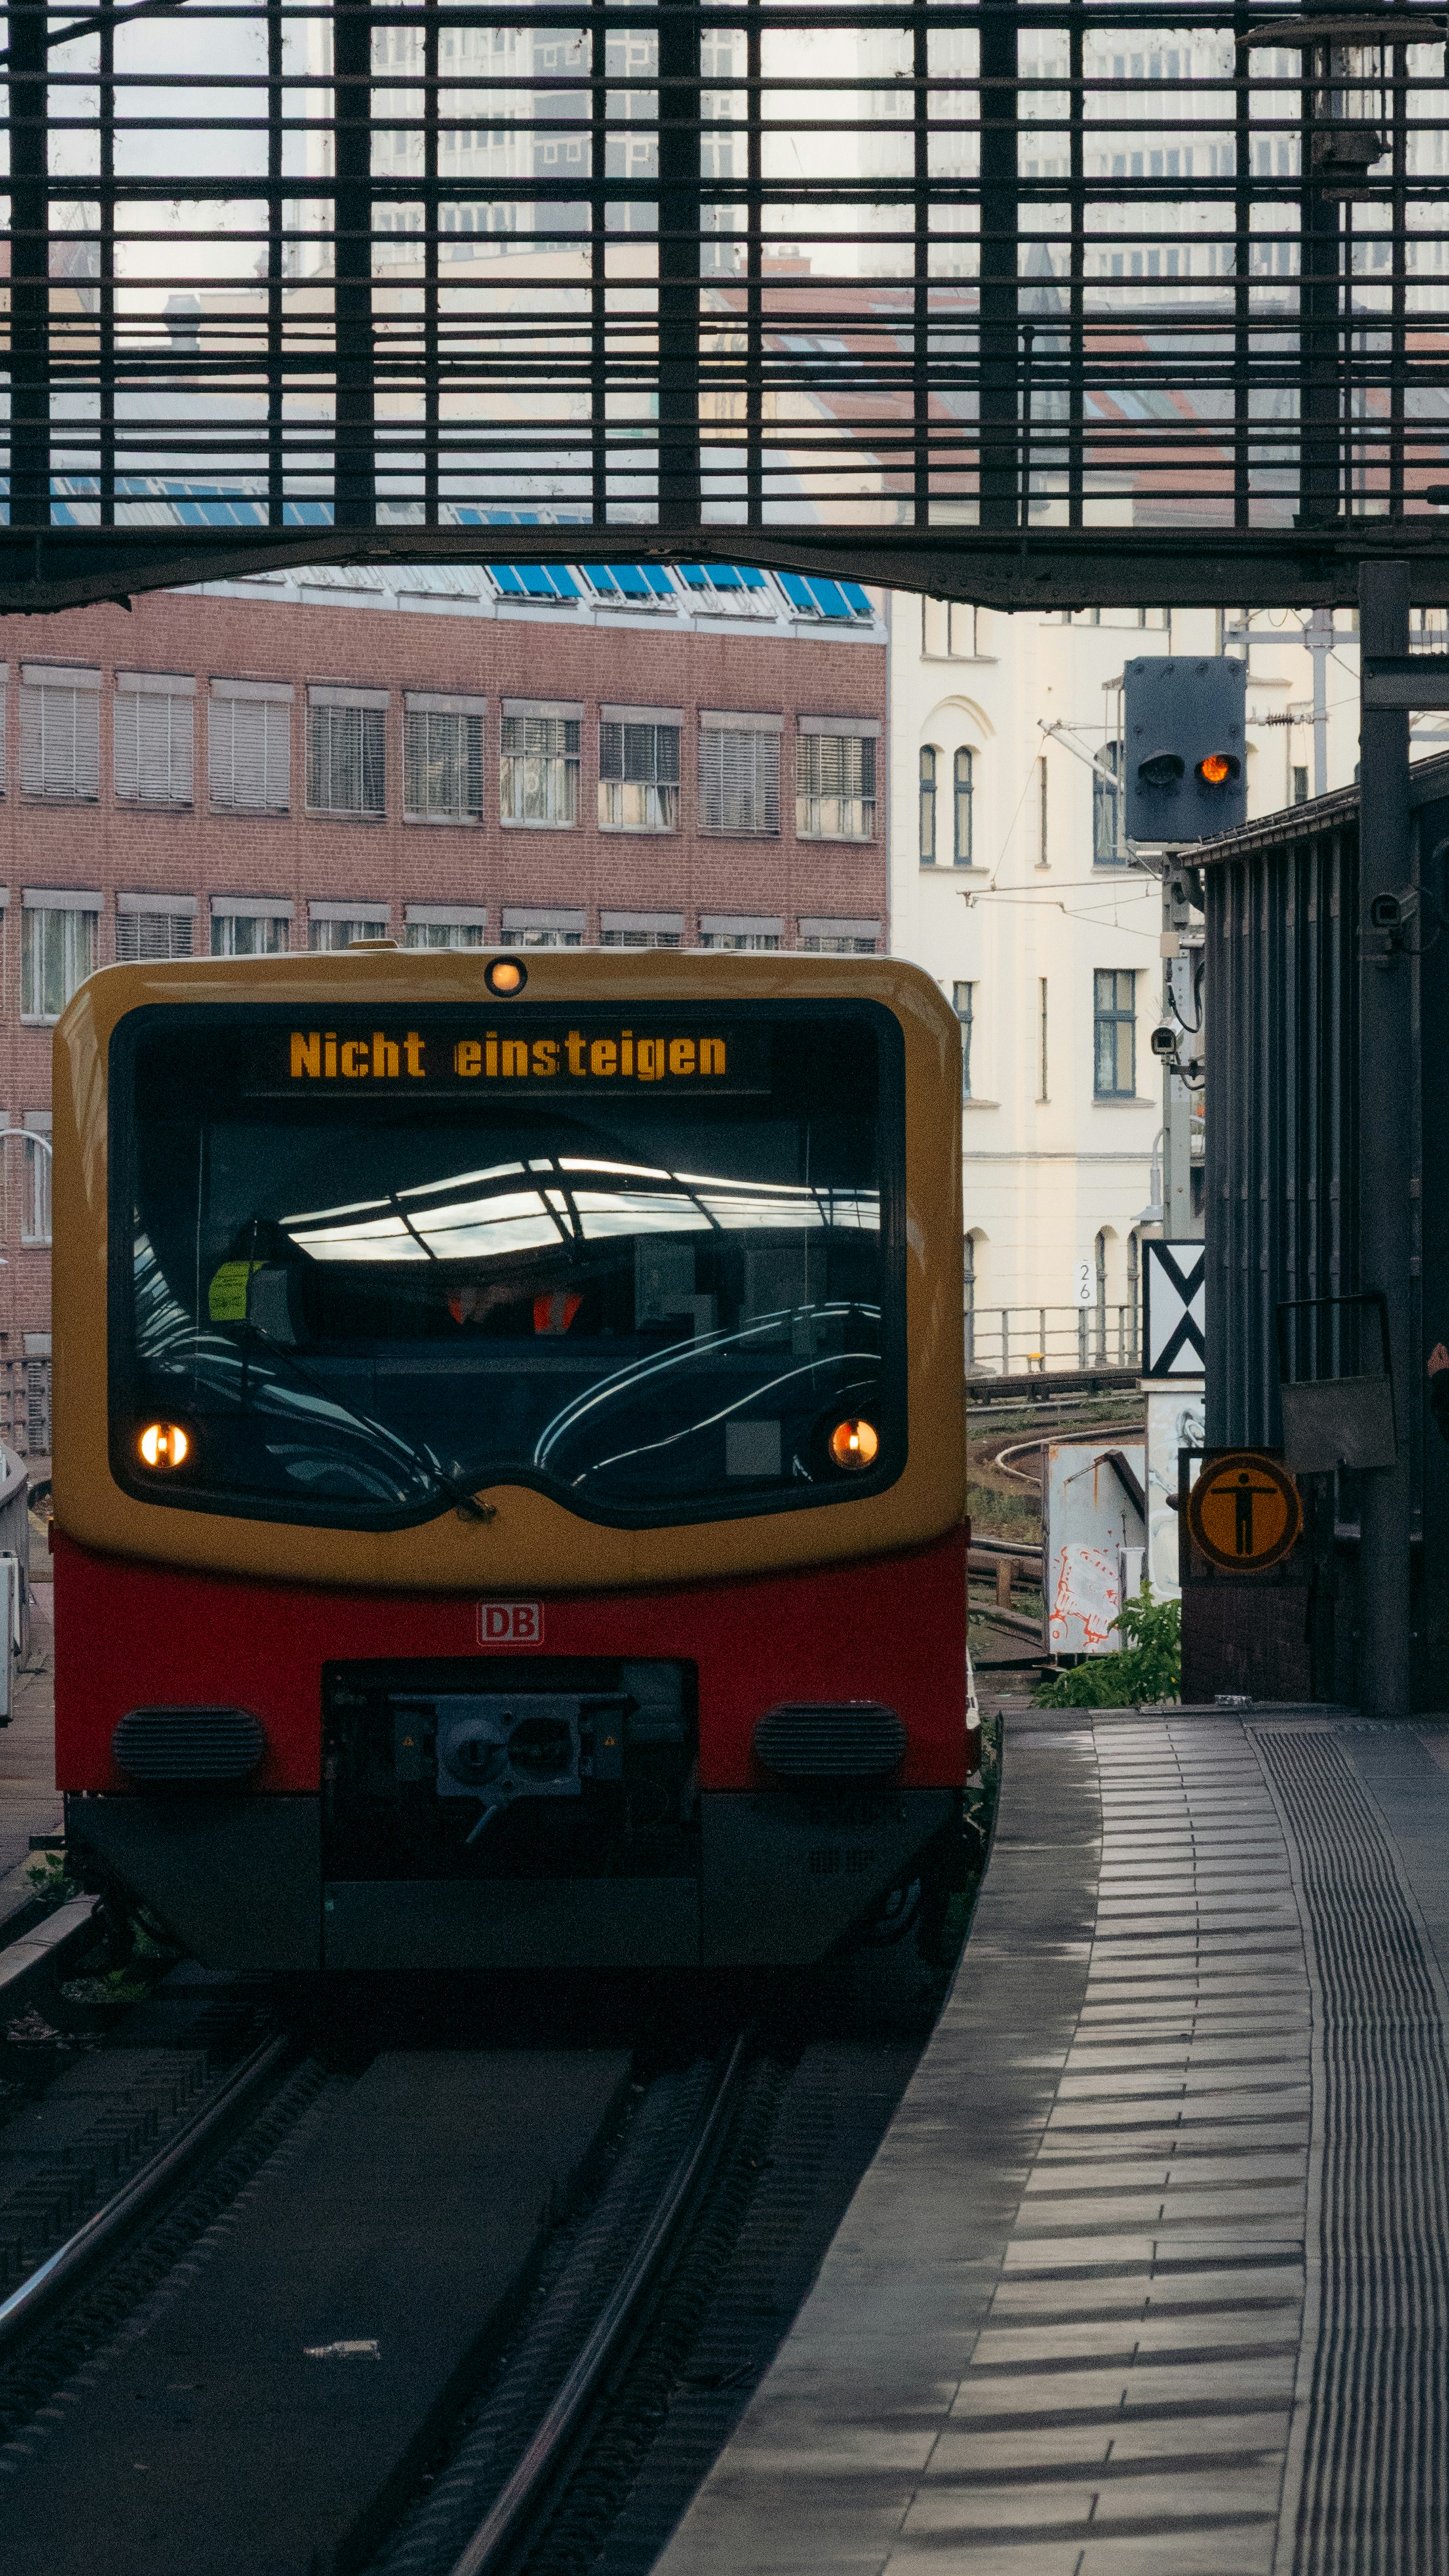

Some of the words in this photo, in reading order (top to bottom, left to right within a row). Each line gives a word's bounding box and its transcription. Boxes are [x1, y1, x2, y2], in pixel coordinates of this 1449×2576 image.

[289, 1032, 426, 1077] Nicht
[454, 1030, 727, 1081] einsteigen
[1081, 1265, 1089, 1280] 2
[1081, 1284, 1090, 1298] 6
[486, 1607, 535, 1638] DB
